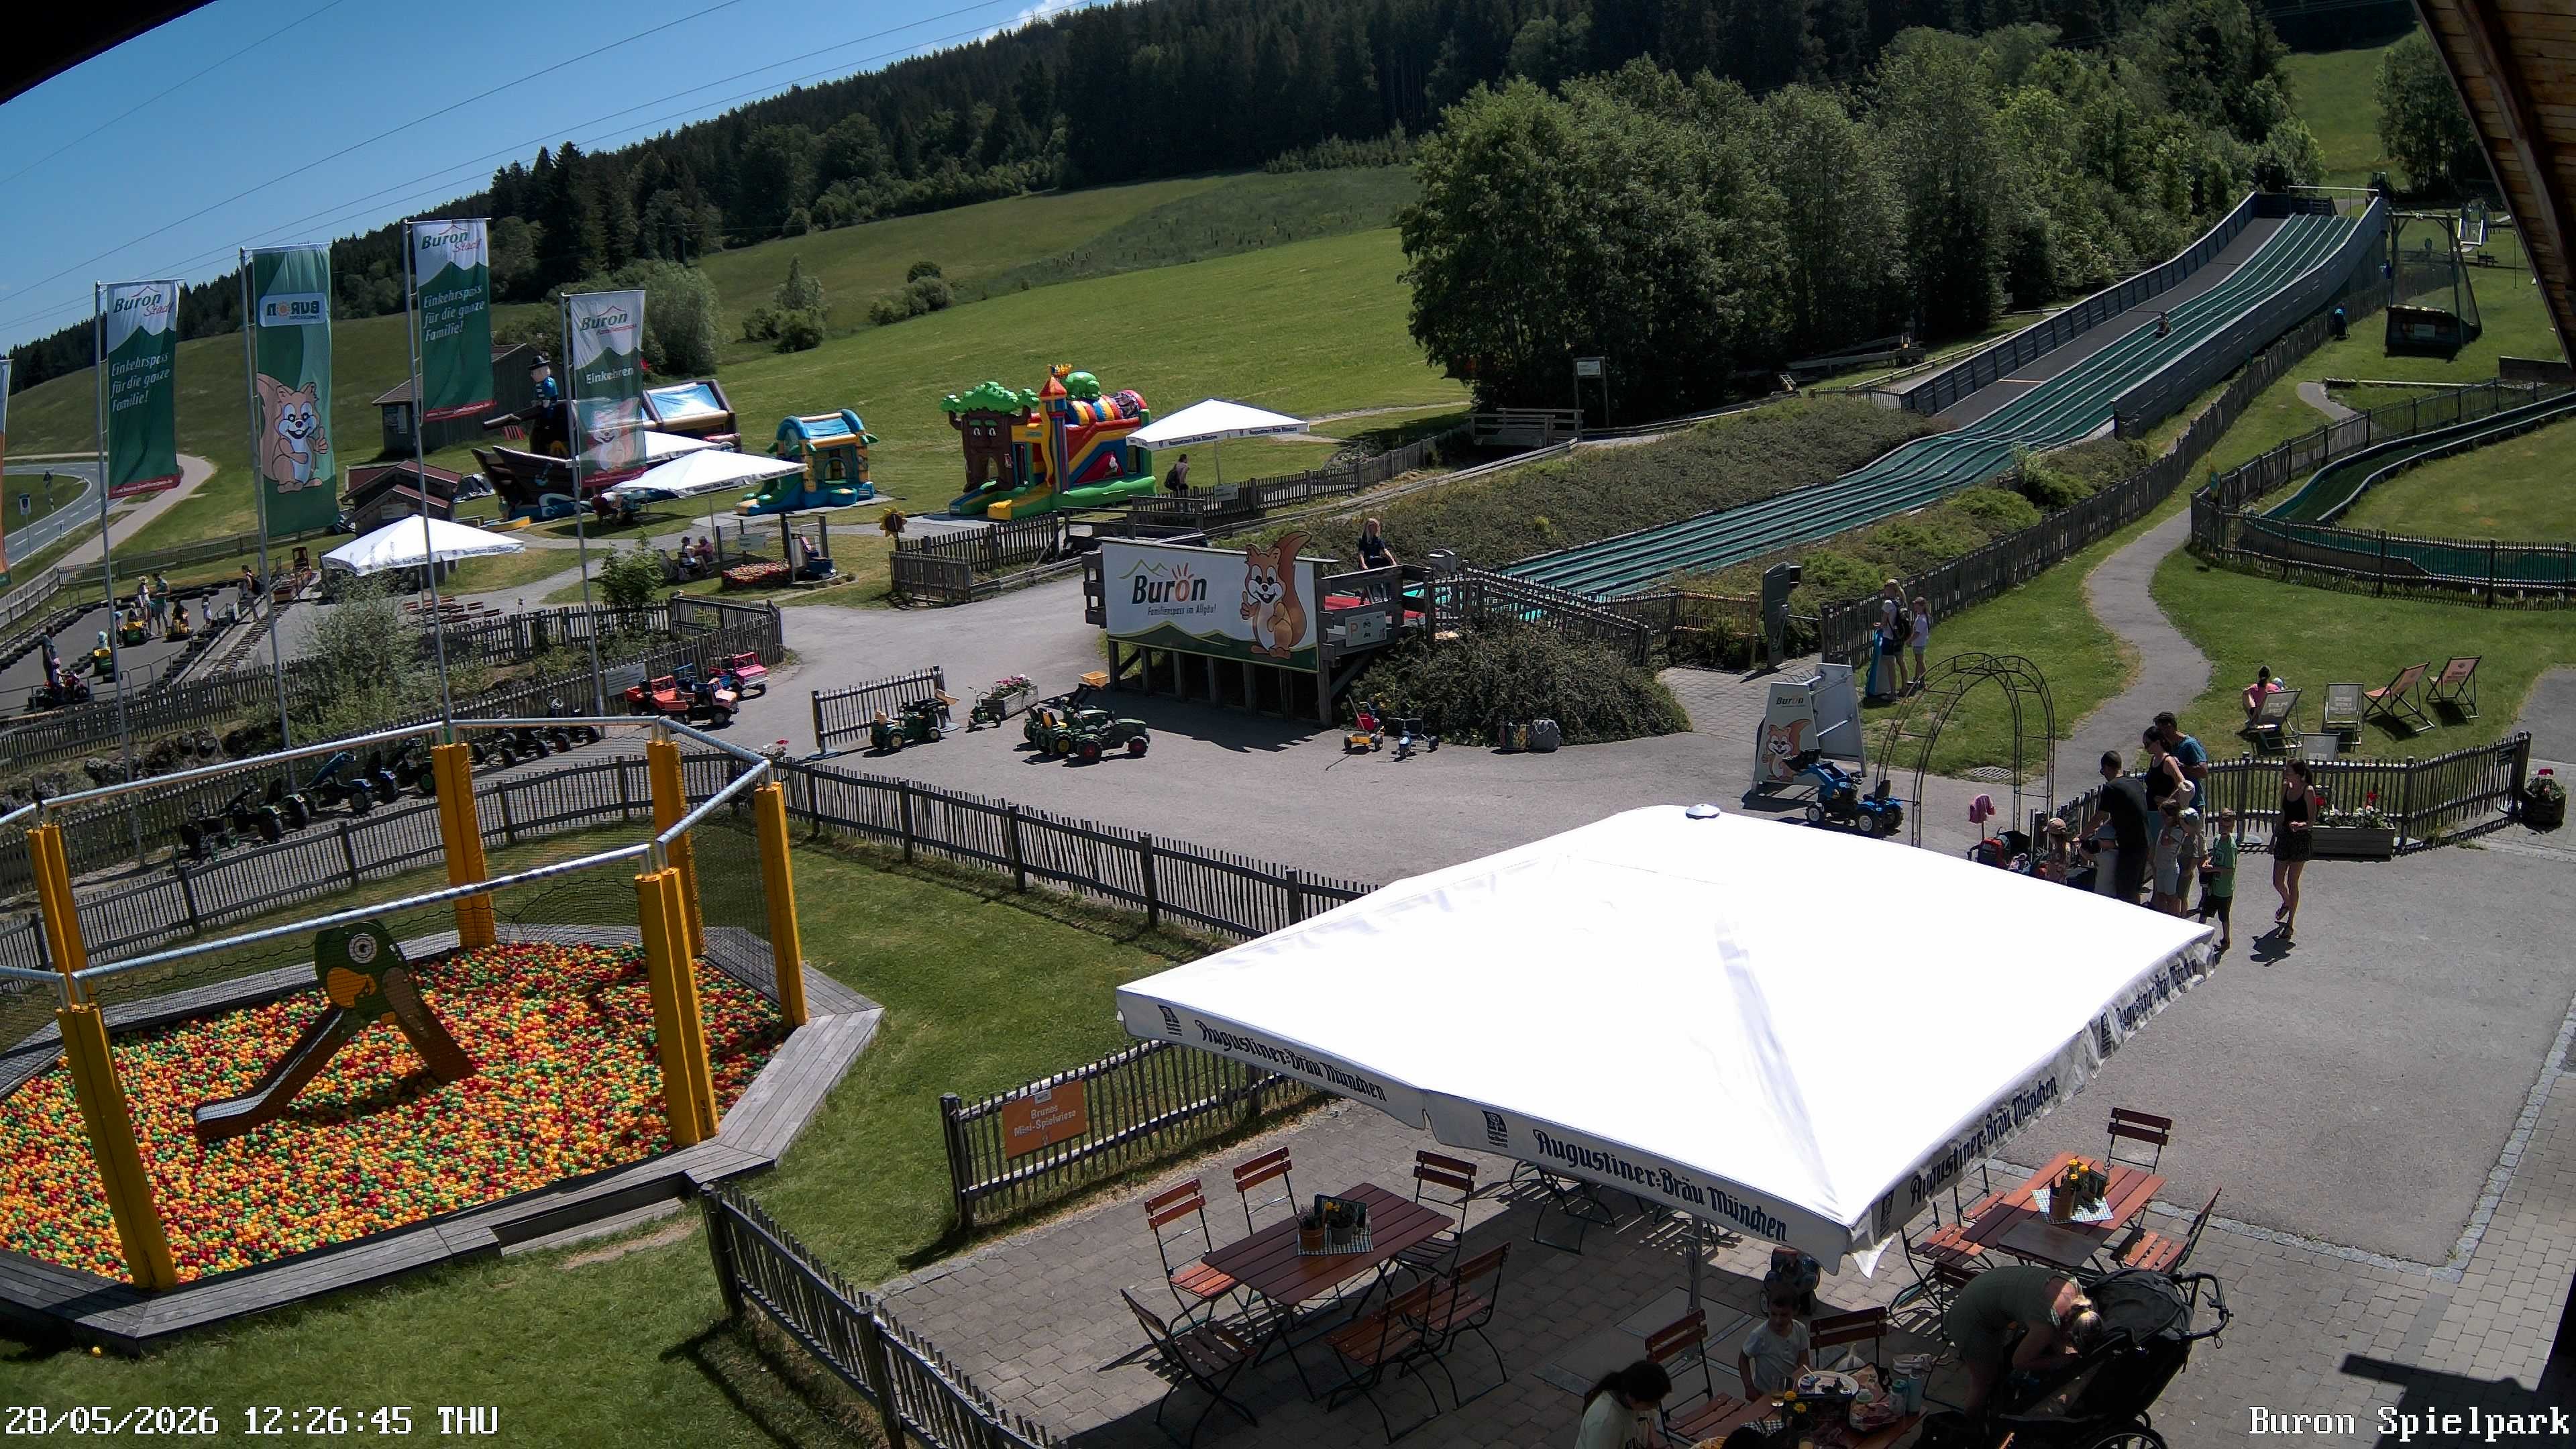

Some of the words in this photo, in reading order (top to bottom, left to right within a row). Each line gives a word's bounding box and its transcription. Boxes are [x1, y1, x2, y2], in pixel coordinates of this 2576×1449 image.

[421, 232, 468, 250] Buron
[113, 294, 162, 313] Buron
[423, 312, 439, 329] für
[441, 307, 456, 320] die
[580, 313, 628, 331] Buron
[111, 381, 125, 398] für
[126, 376, 142, 389] die
[1132, 574, 1208, 604] Buron
[1706, 1186, 1786, 1242] München
